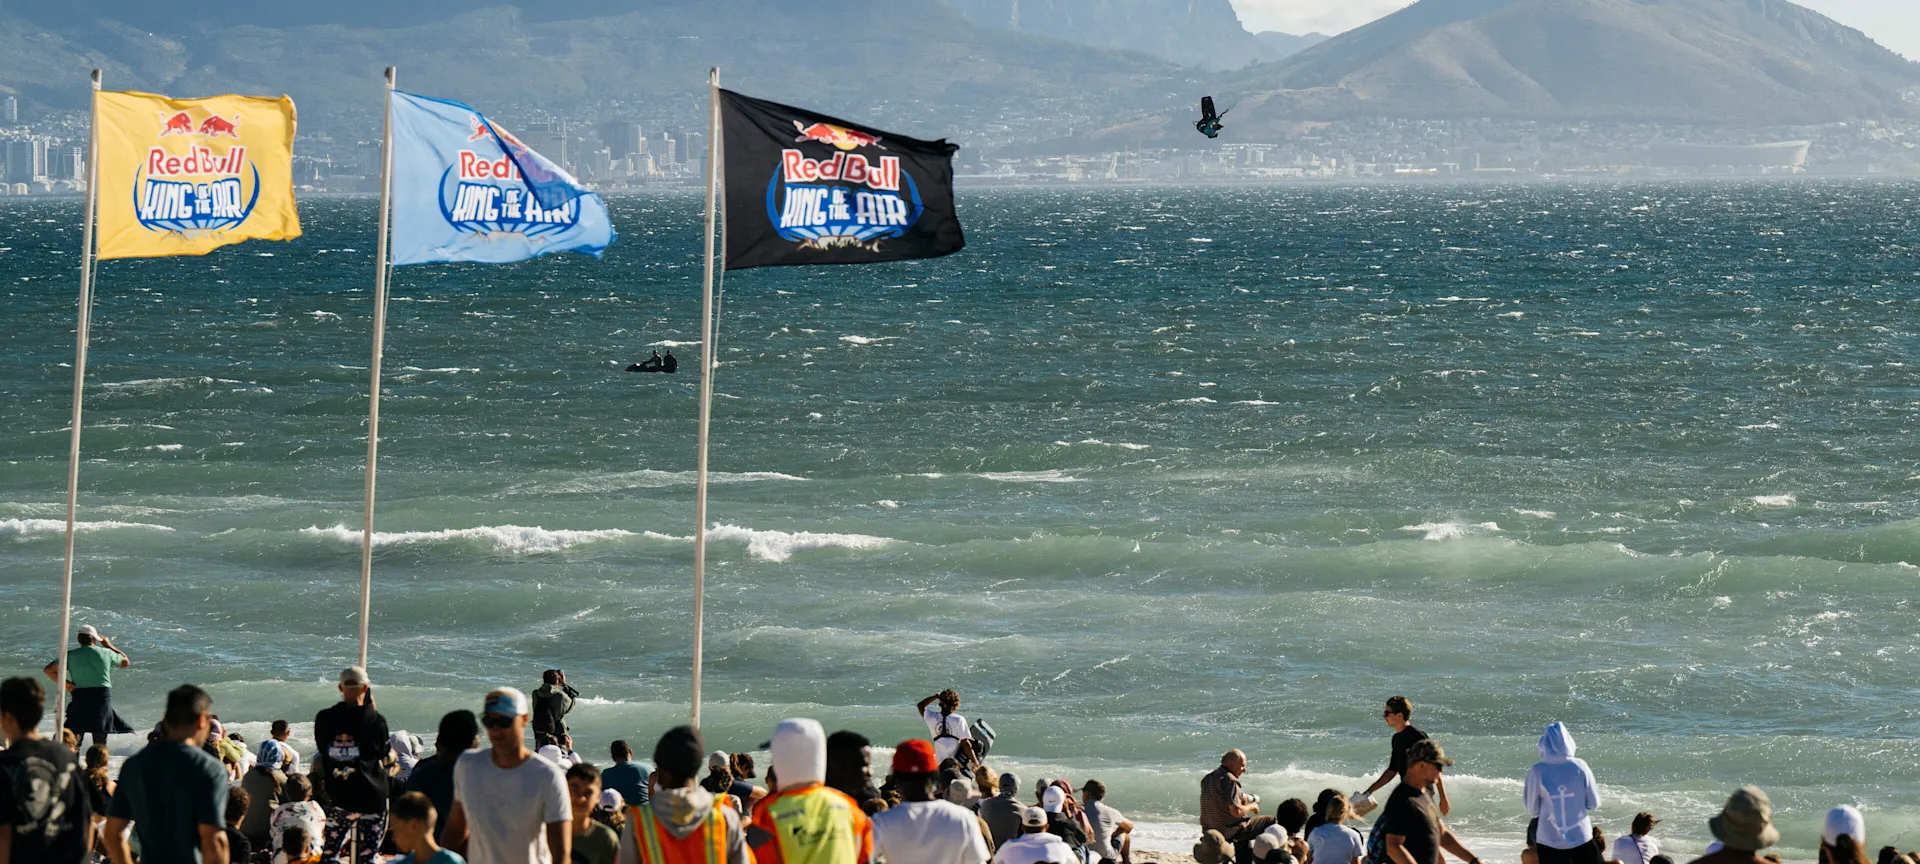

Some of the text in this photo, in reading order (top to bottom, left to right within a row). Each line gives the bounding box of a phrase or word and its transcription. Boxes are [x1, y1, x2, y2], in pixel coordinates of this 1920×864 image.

[148, 145, 245, 175] Red Bull
[459, 150, 510, 179] Red
[783, 151, 898, 188] Red Bull
[141, 180, 244, 220] KING OF THE AIR
[452, 183, 500, 222] KING
[501, 203, 522, 219] THE
[505, 189, 520, 203] OF
[780, 186, 908, 229] KING OF THE AIR
